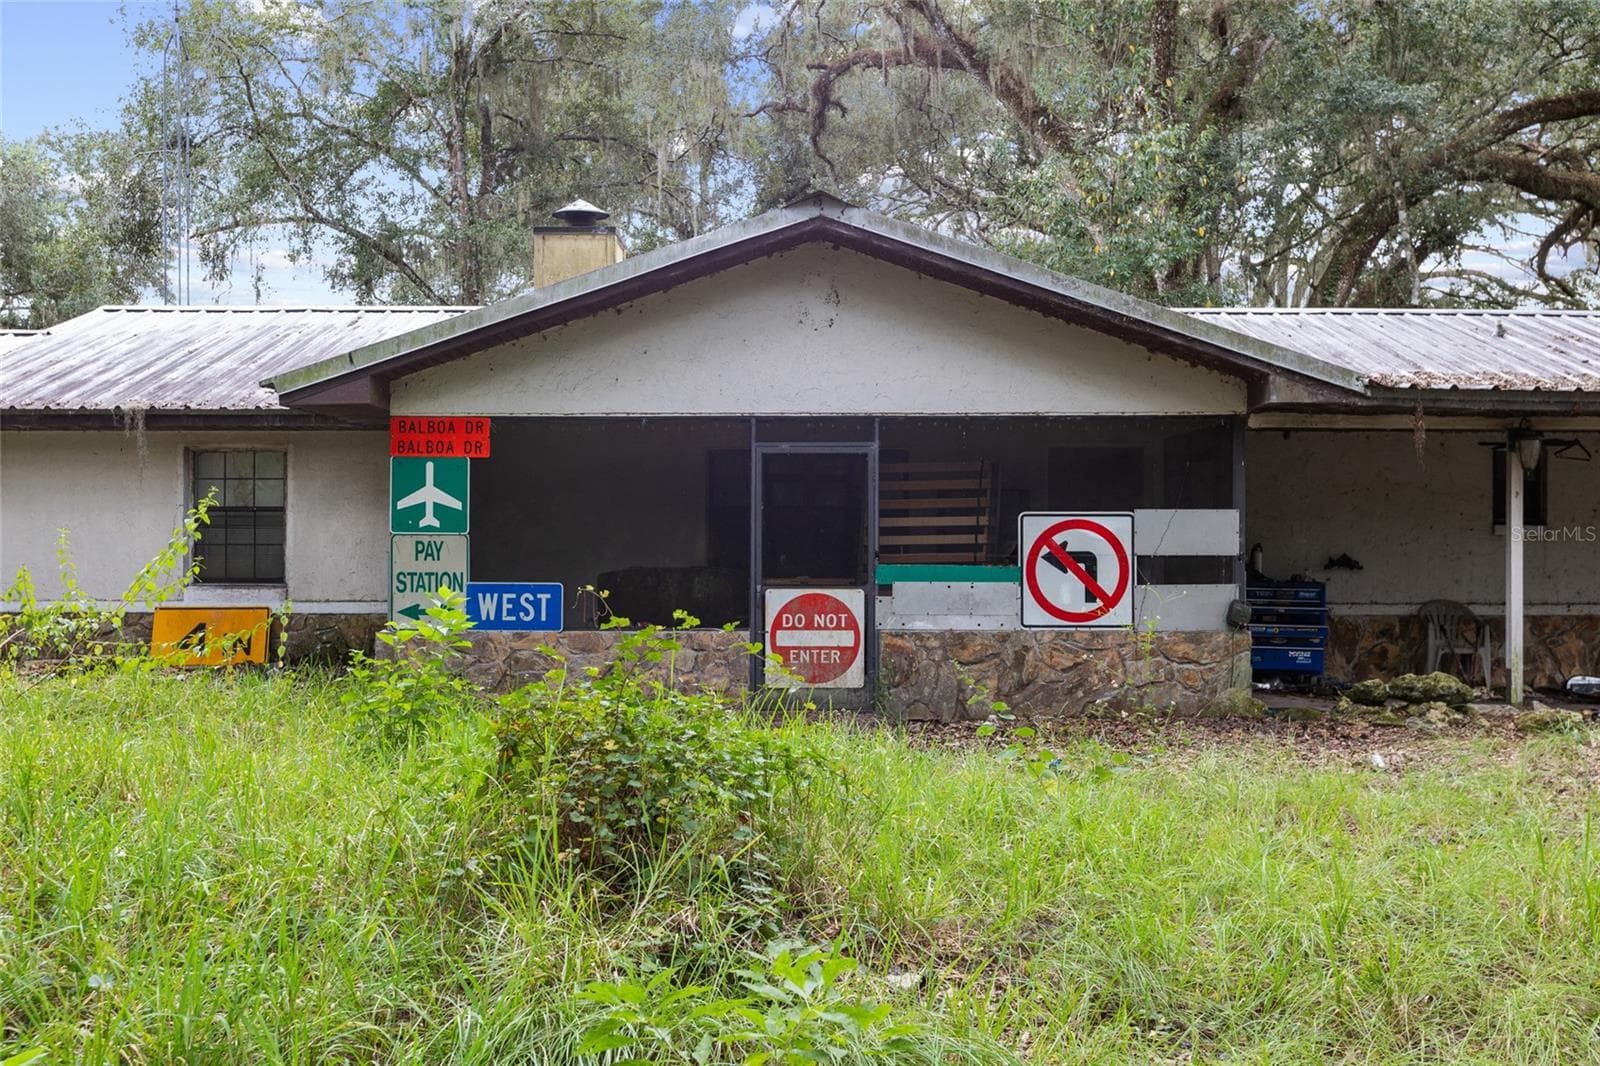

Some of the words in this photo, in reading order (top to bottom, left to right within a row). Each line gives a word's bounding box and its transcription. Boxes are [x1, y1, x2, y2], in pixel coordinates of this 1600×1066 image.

[398, 420, 456, 434] BALBOA
[465, 420, 485, 435] DR
[397, 440, 455, 455] BALBOA
[463, 441, 483, 455] DR
[415, 540, 444, 561] PAY
[395, 571, 464, 593] STATION
[477, 593, 551, 621] WEST
[782, 613, 806, 628] DO
[813, 613, 848, 628] NOT
[790, 649, 841, 664] ENTER
